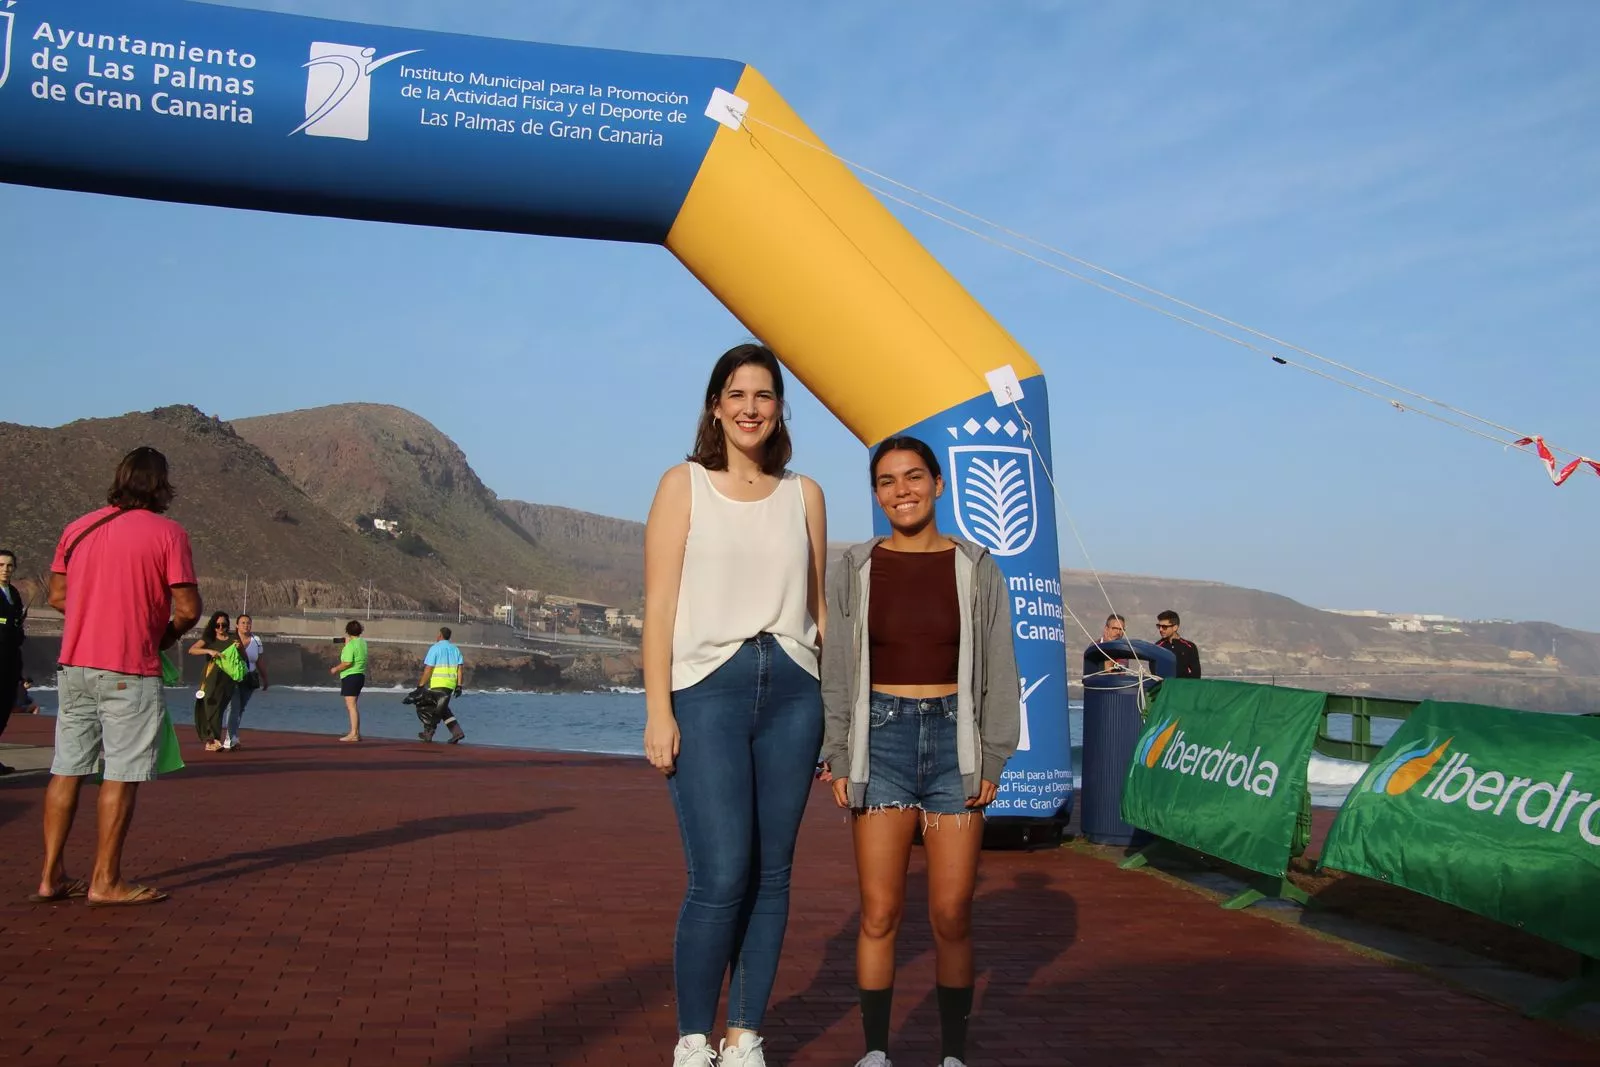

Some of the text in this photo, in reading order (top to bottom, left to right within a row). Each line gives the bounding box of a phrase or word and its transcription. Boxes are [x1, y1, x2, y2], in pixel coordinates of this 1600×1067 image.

[32, 21, 256, 69] Ayuntamiento
[31, 47, 255, 96] de Las Palmas
[400, 65, 689, 105] Instituto Municipal para la Promoción
[31, 76, 253, 124] de Gran Canaria
[401, 83, 687, 124] de la Actividad Física y el Deporte de
[420, 108, 663, 147] Las Palmas de Gran Canaria
[1005, 572, 1061, 597] miento
[1014, 596, 1063, 620] Palmas
[1016, 620, 1065, 643] Canaria
[1000, 769, 1025, 781] cipal
[1026, 771, 1046, 782] para
[1161, 730, 1280, 798] Iberdrola
[986, 798, 1011, 809] mas
[1013, 797, 1028, 809] de
[1029, 798, 1052, 810] Gran
[1037, 784, 1043, 796] y
